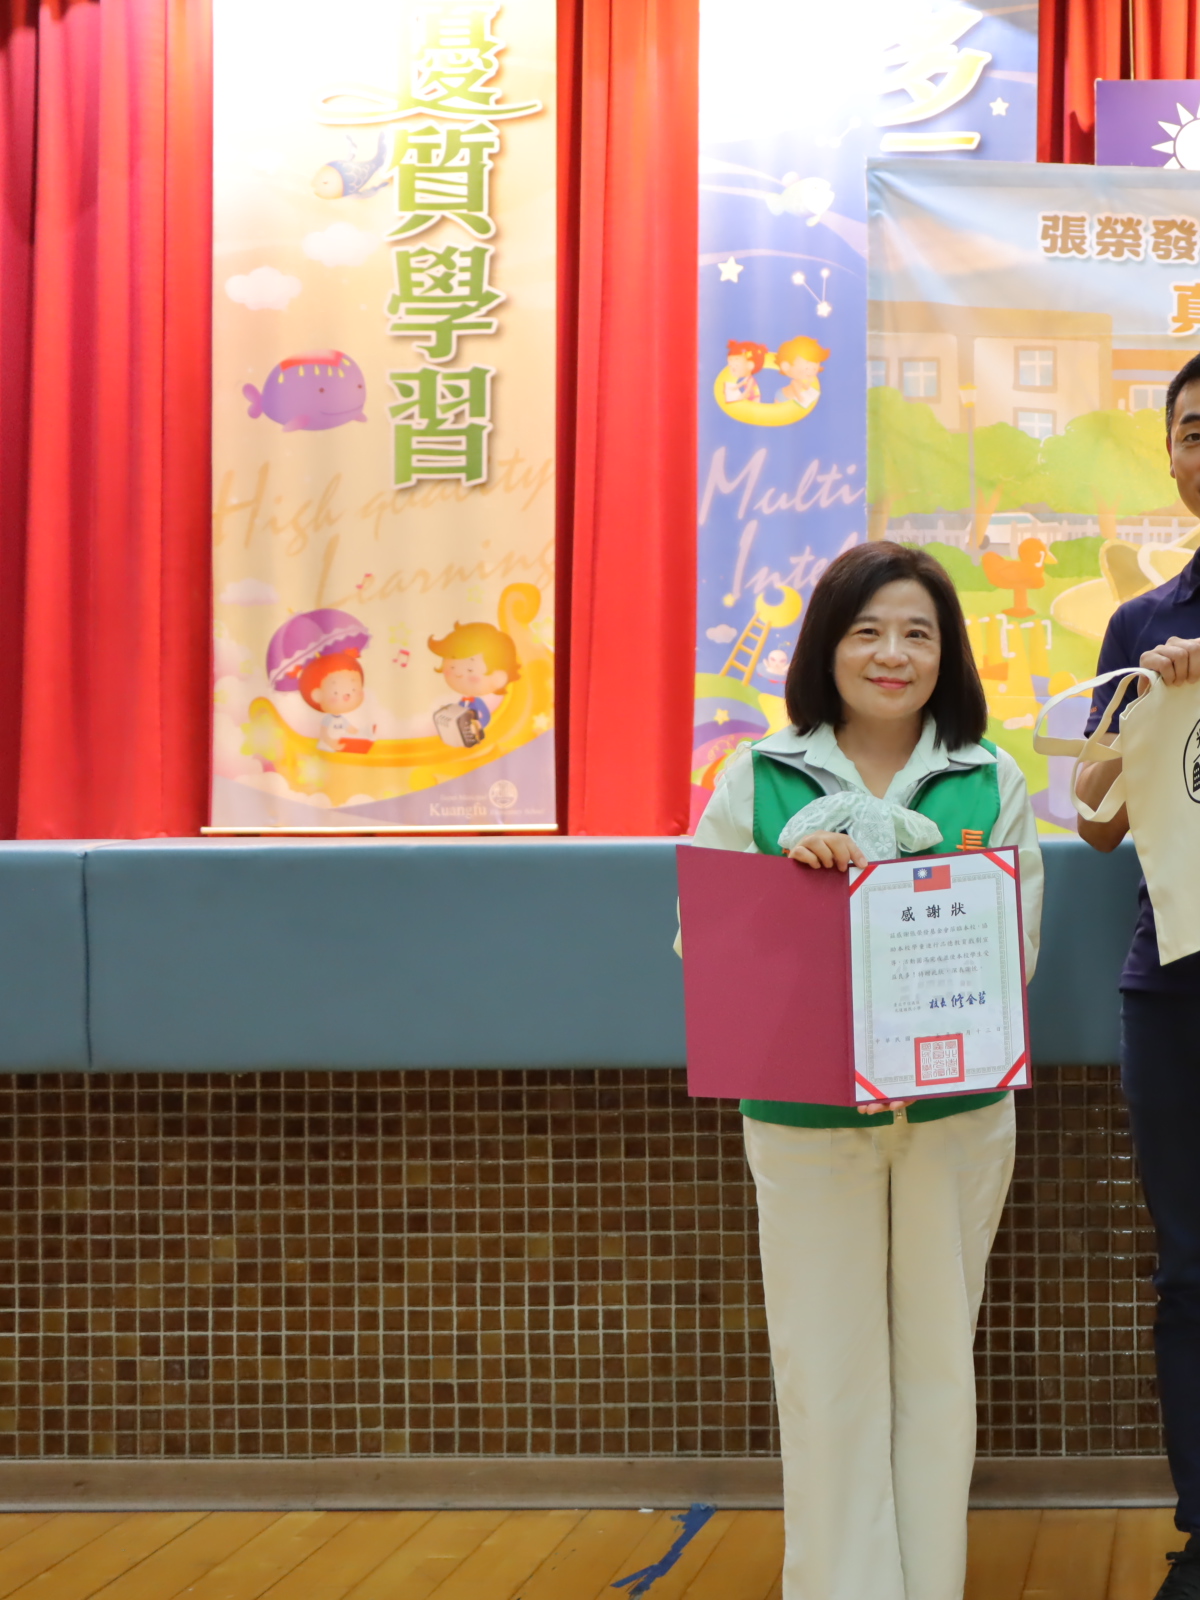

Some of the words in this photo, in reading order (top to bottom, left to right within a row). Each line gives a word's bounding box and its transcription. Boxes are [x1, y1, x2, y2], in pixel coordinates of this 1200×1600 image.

[874, 0, 992, 151] 多
[212, 461, 345, 555] High
[429, 803, 487, 818] Kuangfu
[900, 901, 967, 923] 感謝狀
